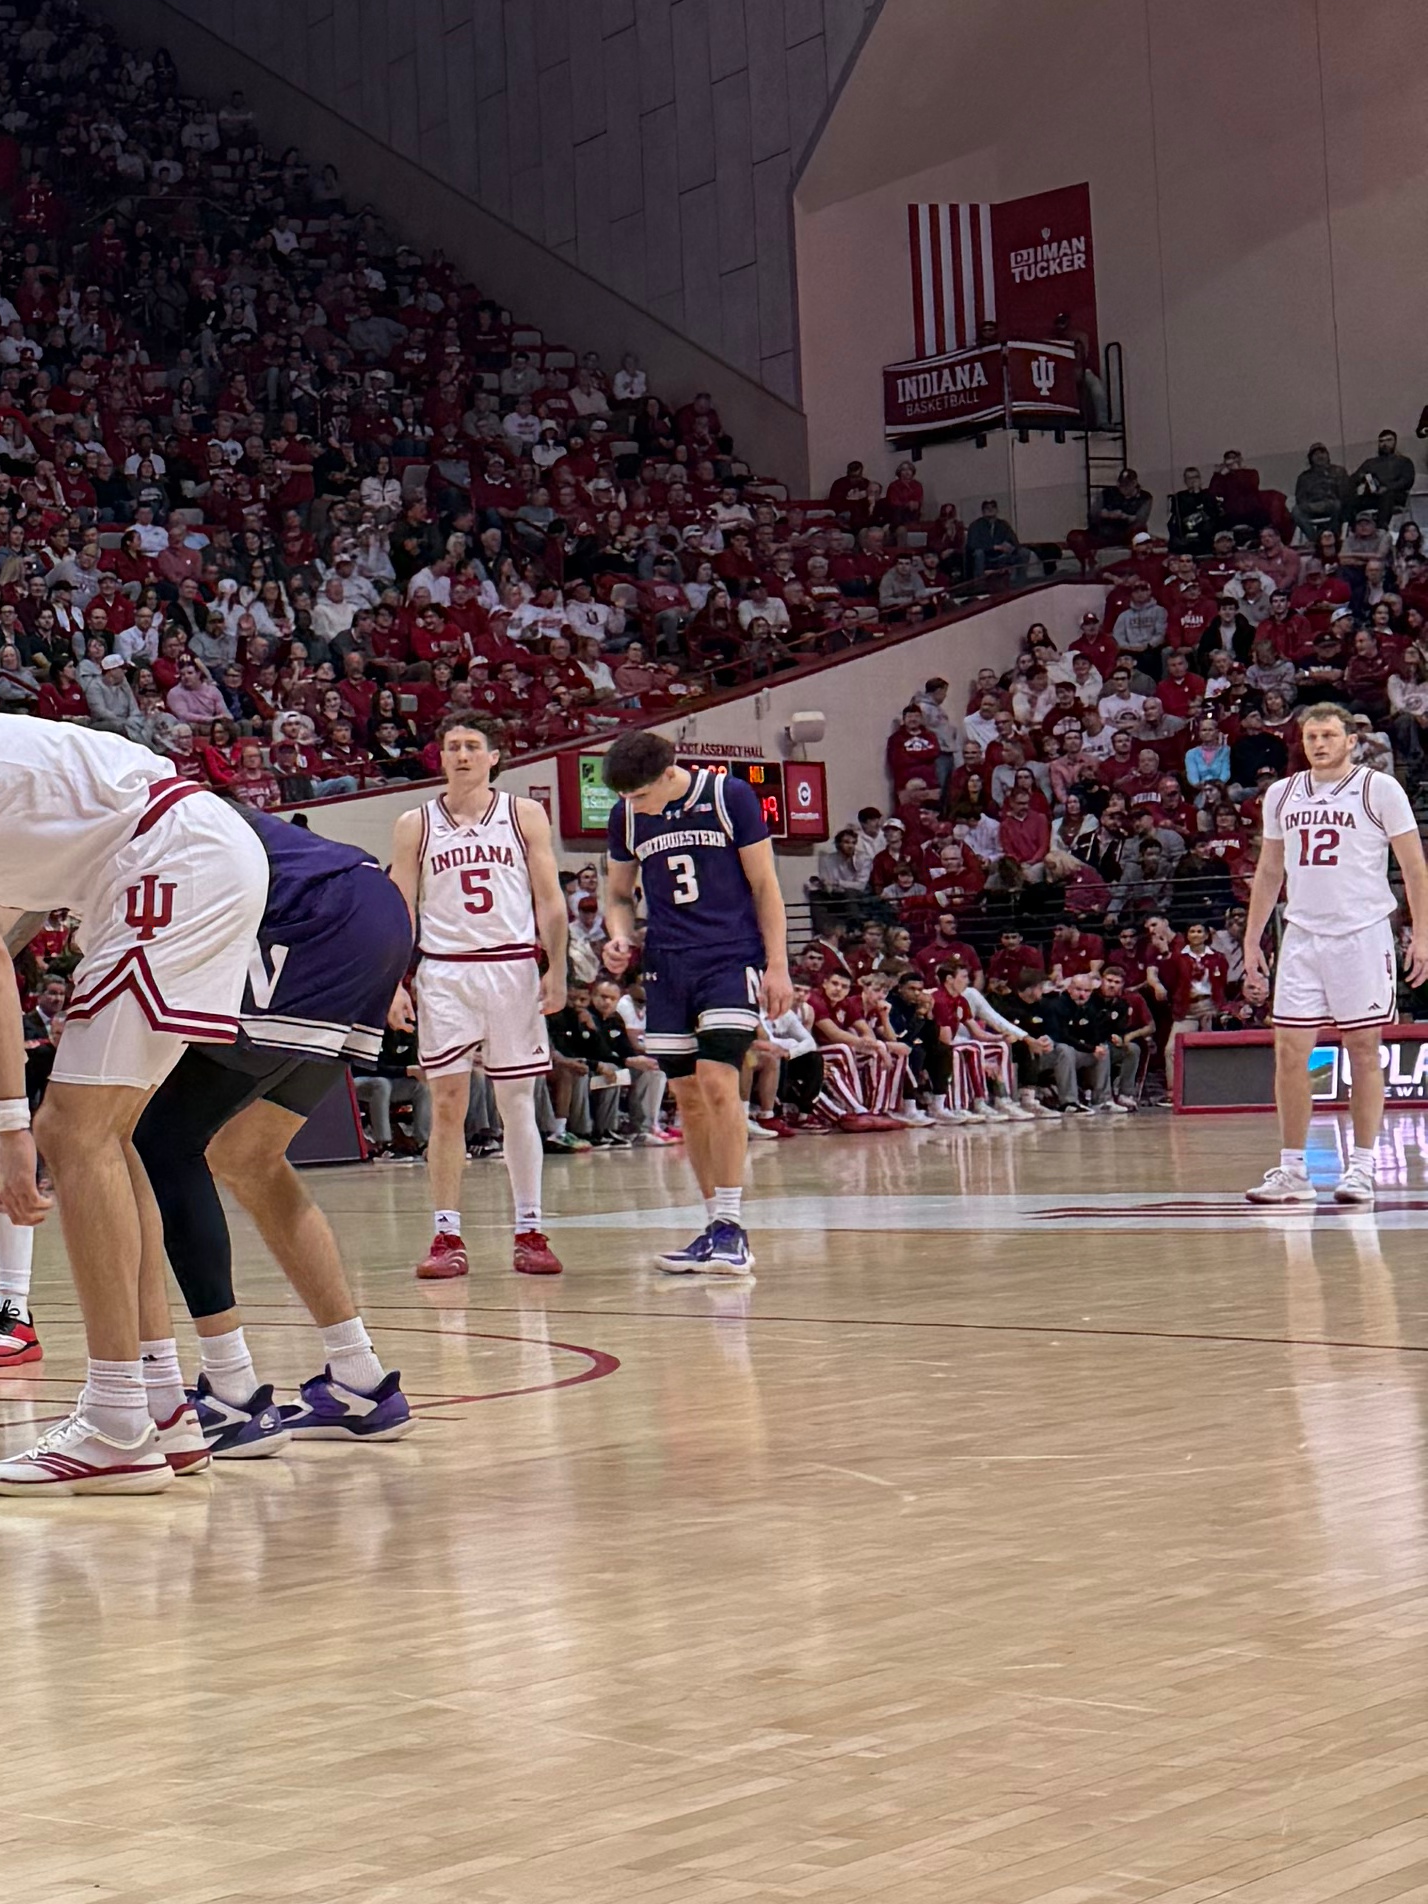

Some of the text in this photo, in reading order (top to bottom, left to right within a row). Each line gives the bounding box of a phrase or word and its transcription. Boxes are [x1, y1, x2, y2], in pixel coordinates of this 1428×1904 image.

[1037, 236, 1085, 262] IMAN
[1011, 253, 1086, 284] TUCKER
[897, 361, 988, 403] INDIANA
[906, 390, 980, 416] BASKETBALL
[700, 743, 742, 757] ASSEMBLY
[744, 746, 765, 758] HALL
[1285, 810, 1357, 831] INDIANA
[431, 844, 514, 876] INDIANA
[1299, 828, 1340, 867] 12
[460, 868, 494, 914] 5
[667, 854, 699, 905] 3
